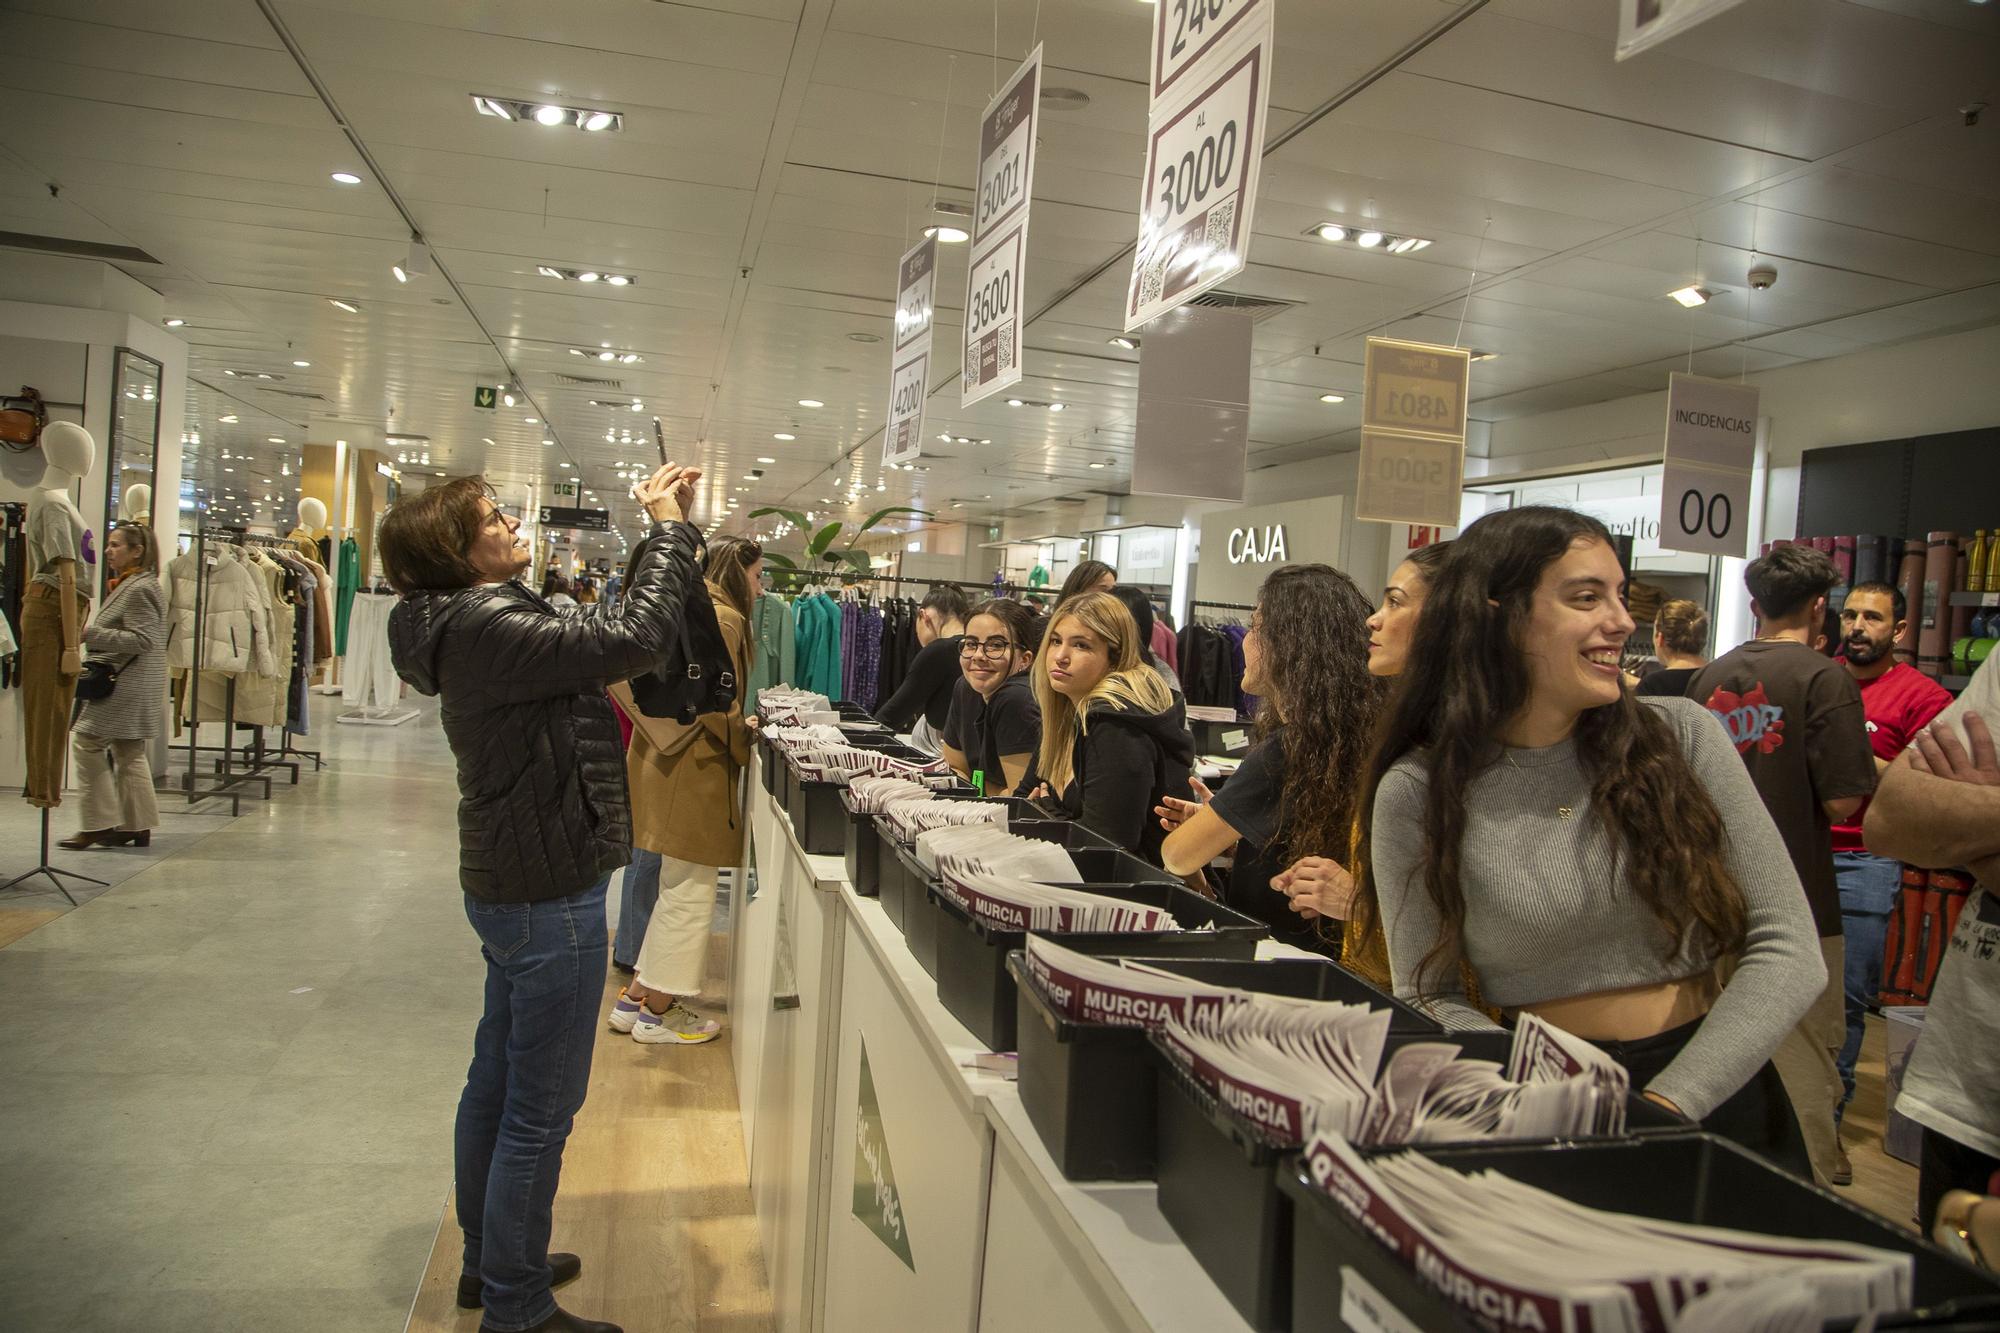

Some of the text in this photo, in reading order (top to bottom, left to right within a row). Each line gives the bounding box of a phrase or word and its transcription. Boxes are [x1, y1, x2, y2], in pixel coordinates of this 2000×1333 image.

[1196, 111, 1206, 131] AL
[982, 153, 1020, 223] 3001
[1157, 119, 1237, 228] 3000
[972, 269, 1010, 333] 3600
[895, 379, 921, 417] 4200
[1676, 409, 1752, 434] INCIDENCIAS
[541, 508, 551, 522] 3
[1679, 489, 1732, 539] 00
[1228, 524, 1287, 564] CAJA
[975, 897, 1025, 927] MURCIA
[1085, 987, 1172, 1021] MURCIA
[1218, 1079, 1291, 1132] MURCIA
[1415, 1245, 1547, 1333] MURCIA
